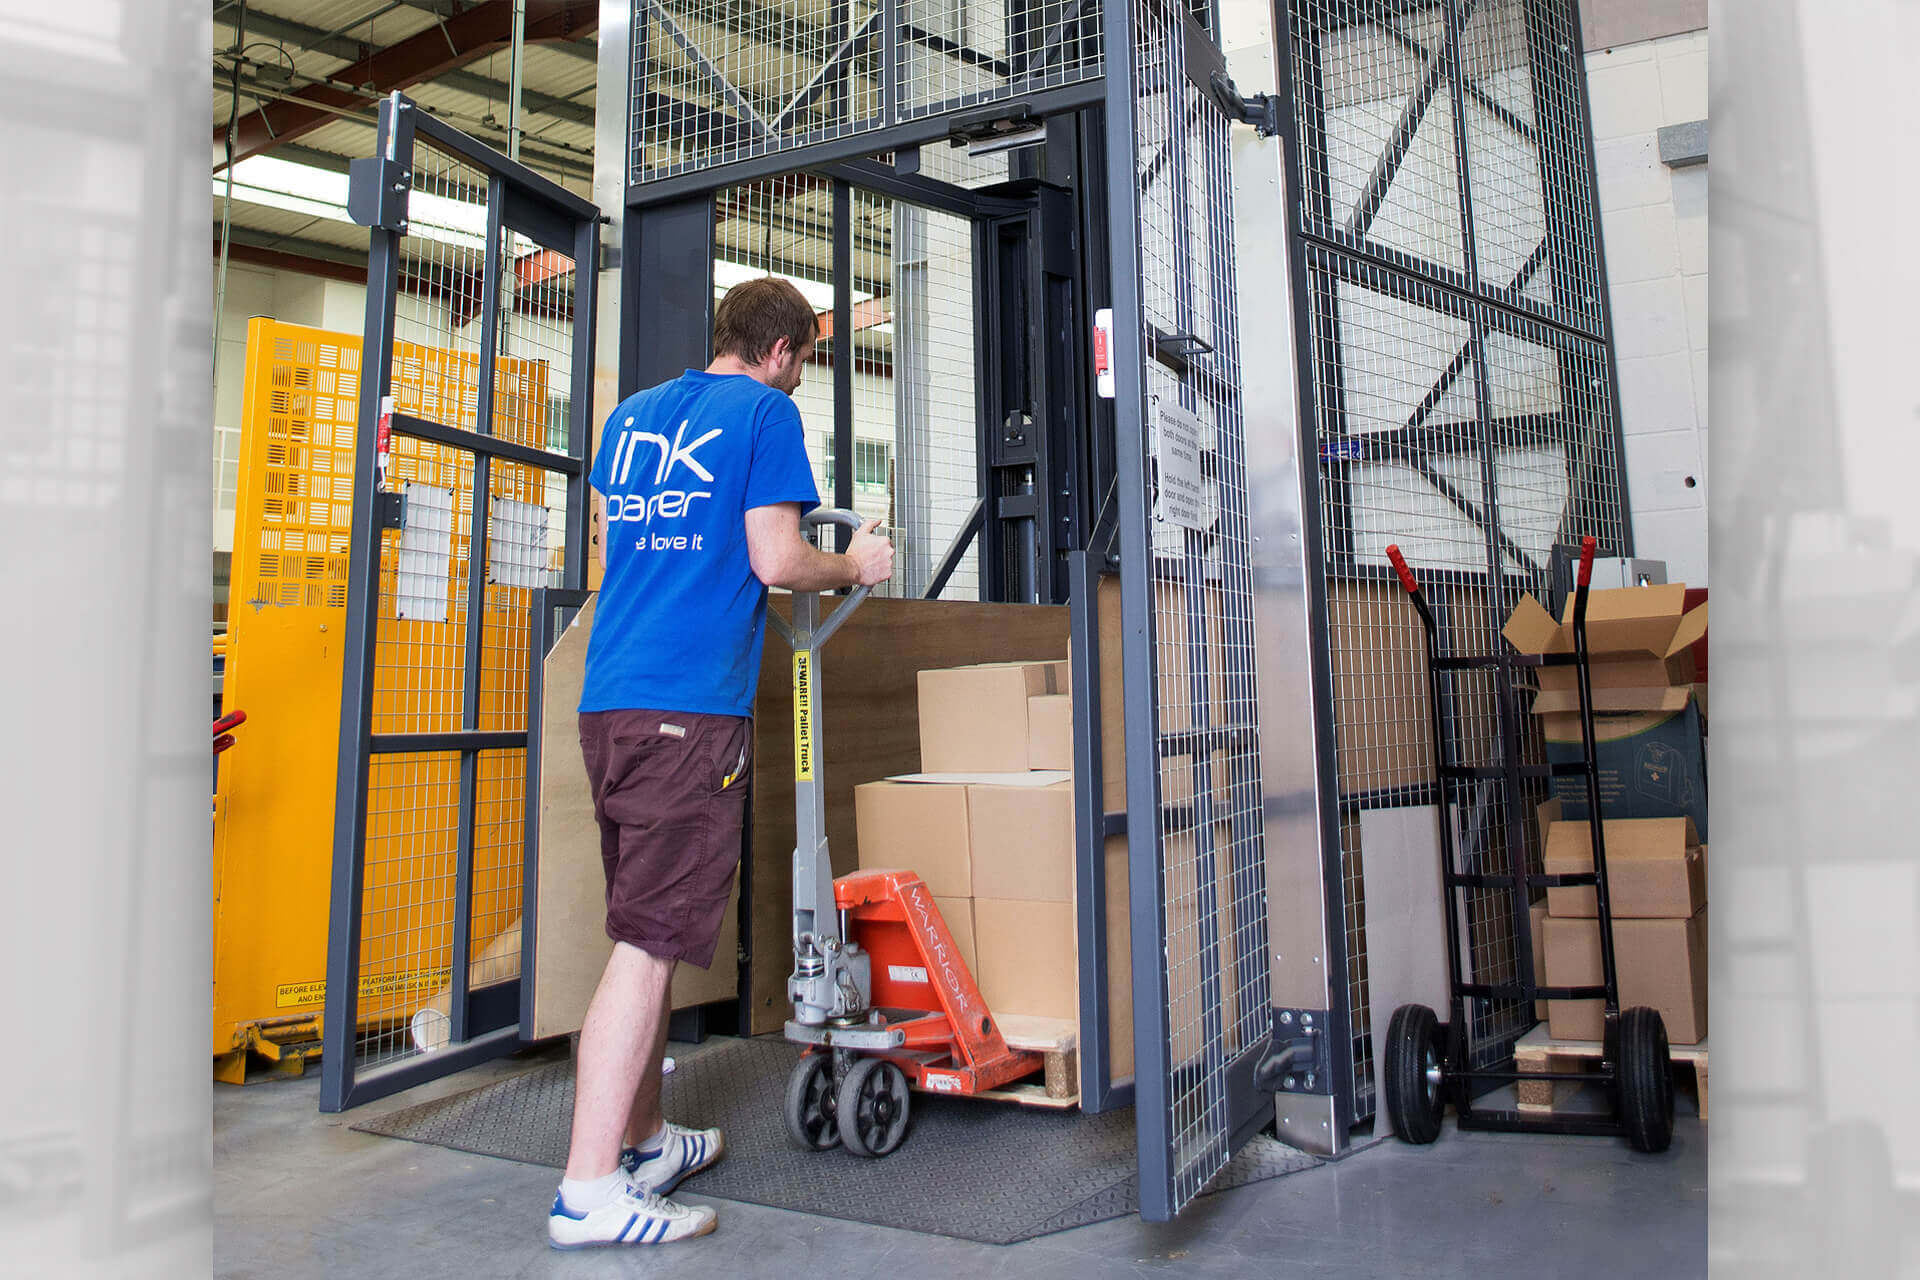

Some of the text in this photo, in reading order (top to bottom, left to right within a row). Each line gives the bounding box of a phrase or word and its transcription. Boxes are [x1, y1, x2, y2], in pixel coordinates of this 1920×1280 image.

[1160, 409, 1177, 426] Please
[1163, 426, 1175, 439] both
[610, 416, 723, 485] ink
[1172, 446, 1183, 458] same
[1165, 472, 1176, 485] Hold
[1164, 488, 1176, 499] door
[1169, 504, 1180, 517] right
[651, 532, 688, 551] love
[692, 533, 704, 551] it
[800, 709, 809, 740] Pallet
[801, 743, 809, 773] Truck
[911, 887, 968, 1013] WARRIOR
[279, 985, 308, 995] BEFORE
[362, 974, 397, 985] PLATFORM
[297, 994, 313, 1003] AND
